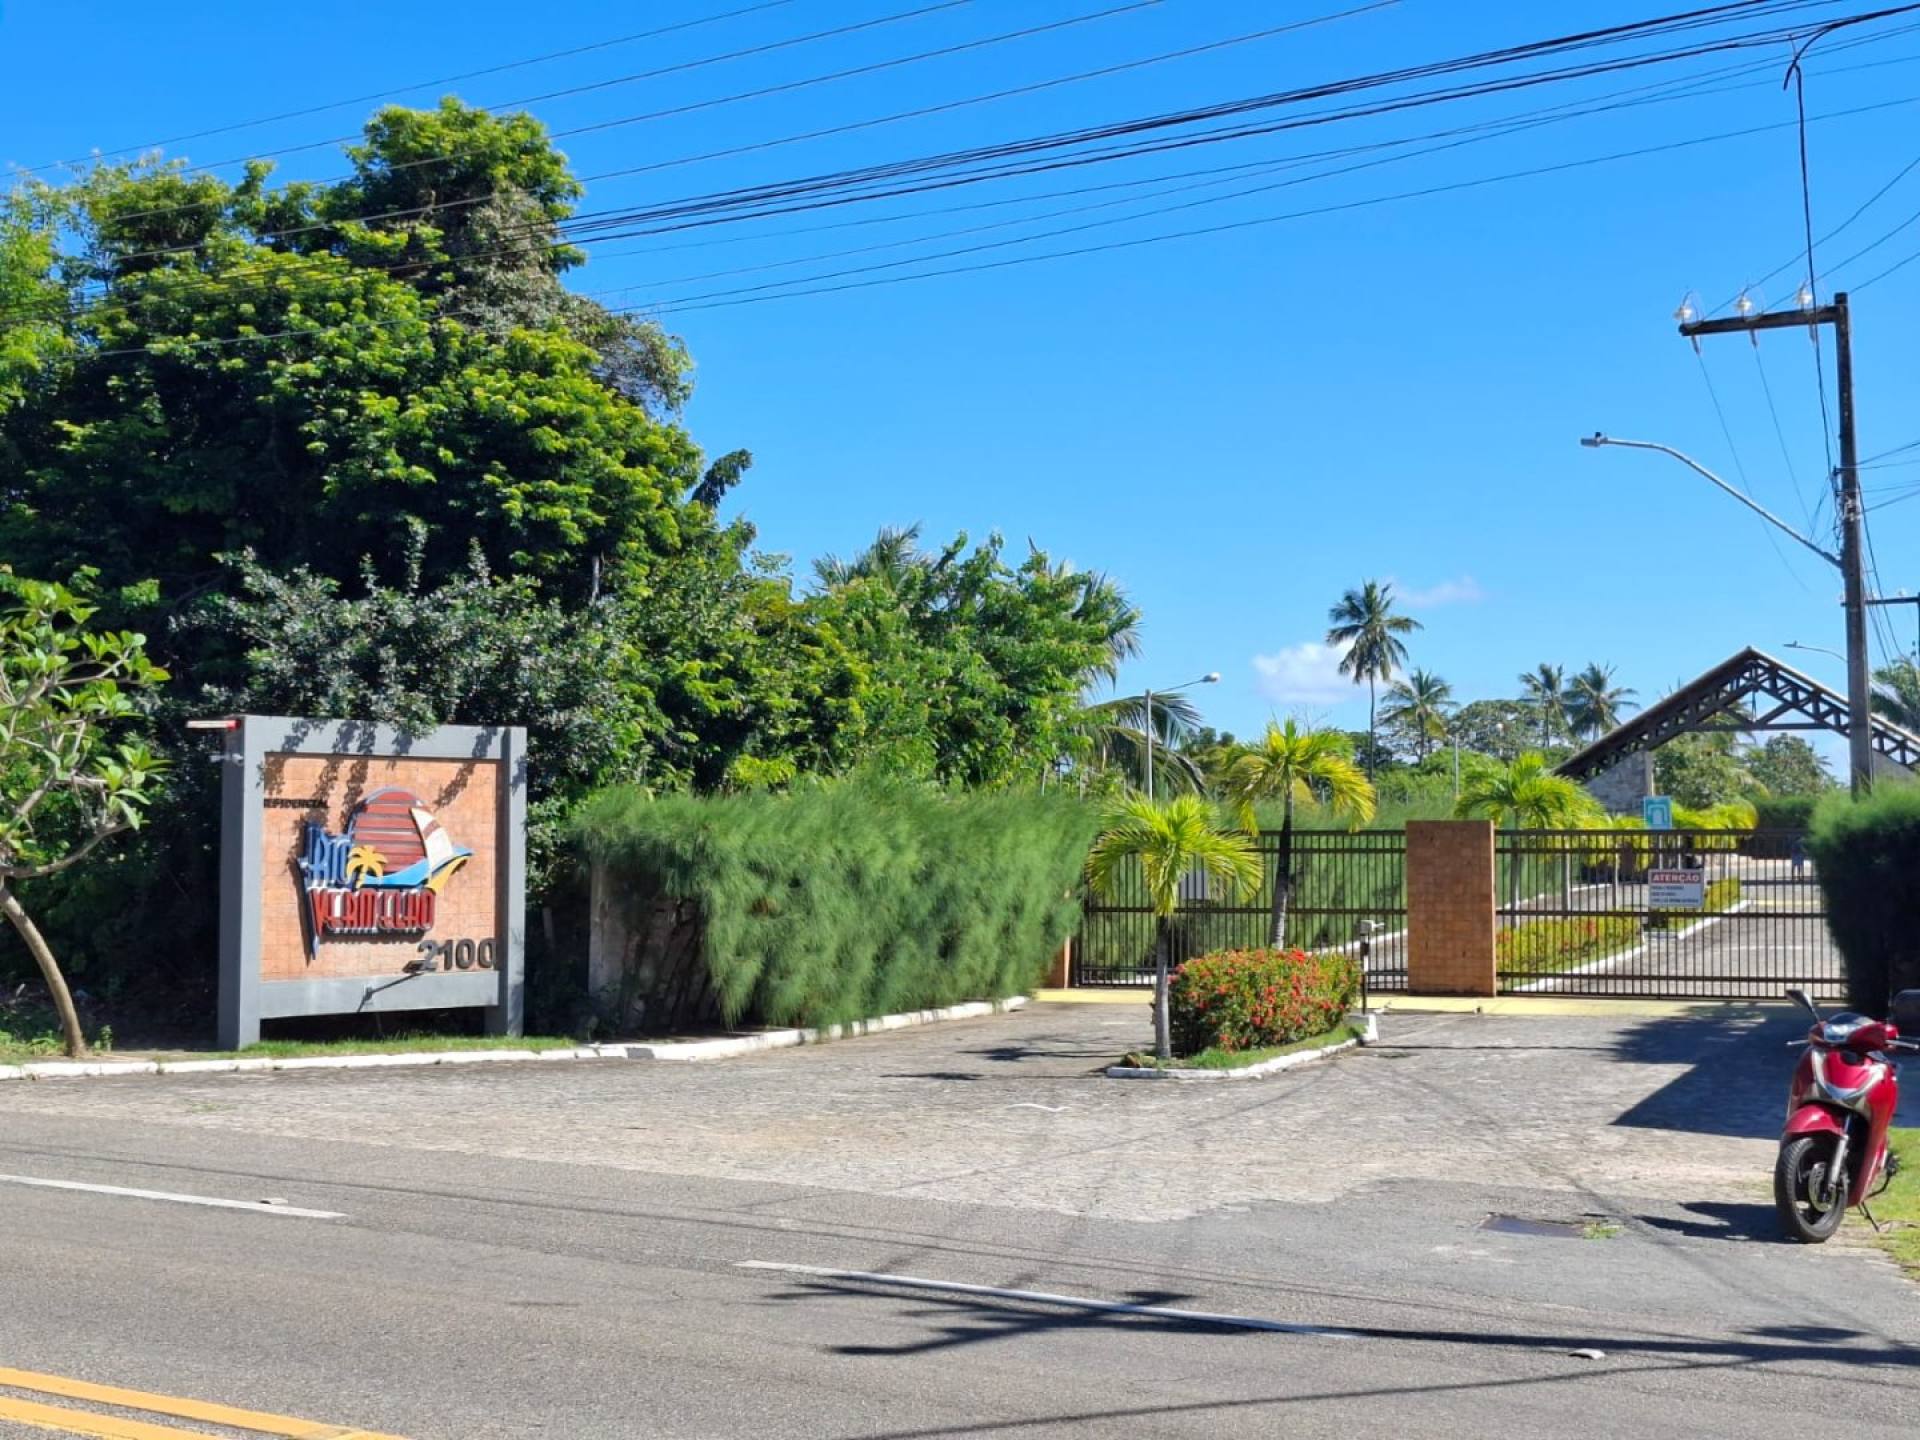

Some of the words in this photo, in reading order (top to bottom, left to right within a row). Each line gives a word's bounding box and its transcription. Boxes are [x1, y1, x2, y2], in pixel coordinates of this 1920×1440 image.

[298, 826, 357, 888] RIO
[1653, 873, 1699, 882] ATENÇÃO
[310, 888, 436, 936] VERMELHO
[413, 937, 497, 973] 2100
